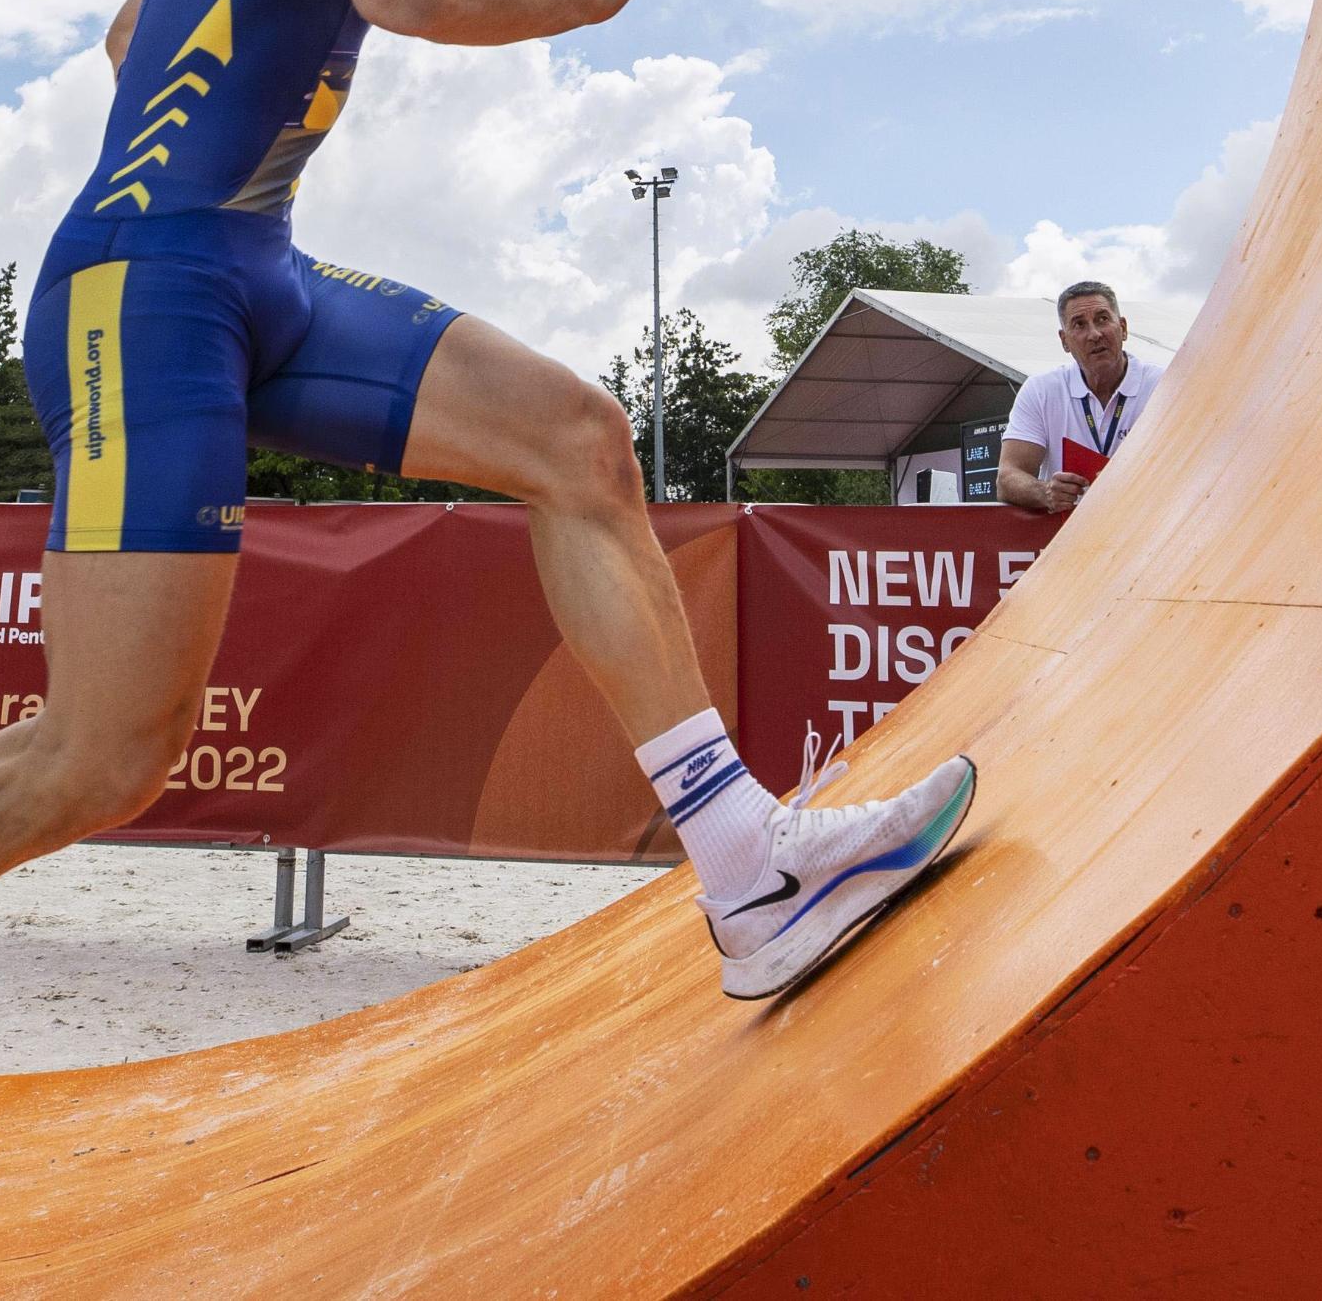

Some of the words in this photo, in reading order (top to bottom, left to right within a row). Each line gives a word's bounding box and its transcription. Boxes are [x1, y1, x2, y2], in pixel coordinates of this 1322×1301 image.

[84, 329, 104, 461] uipmworld.org
[828, 550, 975, 608] NEW
[687, 749, 716, 776] NIKE
